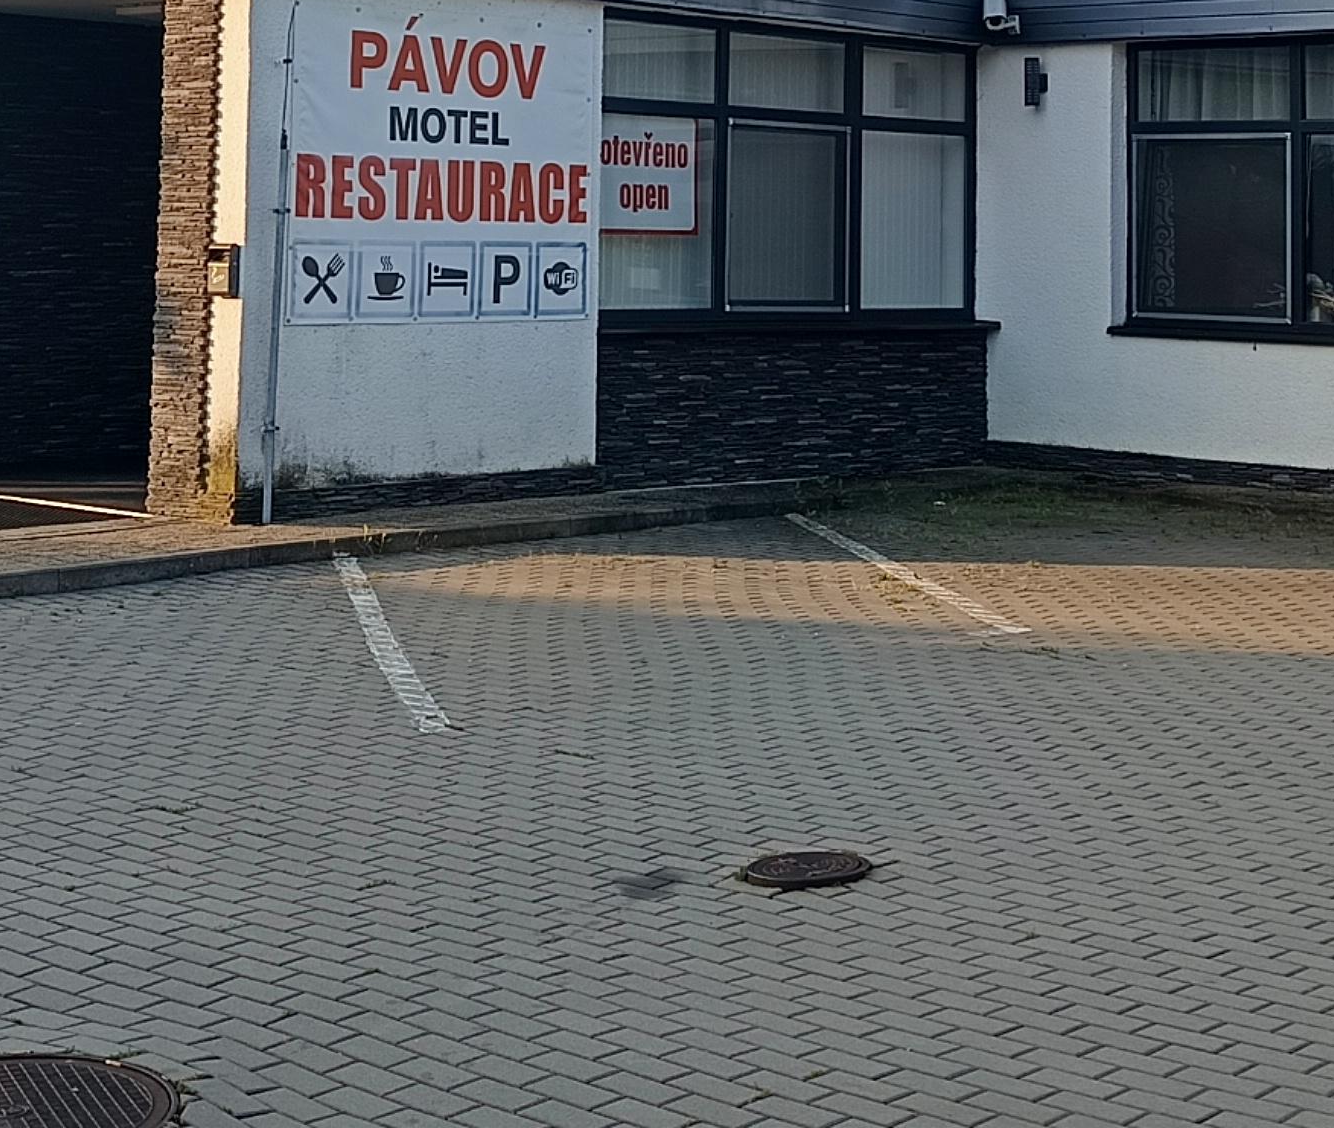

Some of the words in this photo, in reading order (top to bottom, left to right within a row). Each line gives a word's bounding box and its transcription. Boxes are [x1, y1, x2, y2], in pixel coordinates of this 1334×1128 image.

[349, 16, 546, 100] PÁVOV
[389, 106, 509, 146] MOTEL
[600, 132, 688, 168] otevřeno
[295, 153, 588, 223] RESTAURACE
[620, 183, 670, 212] open
